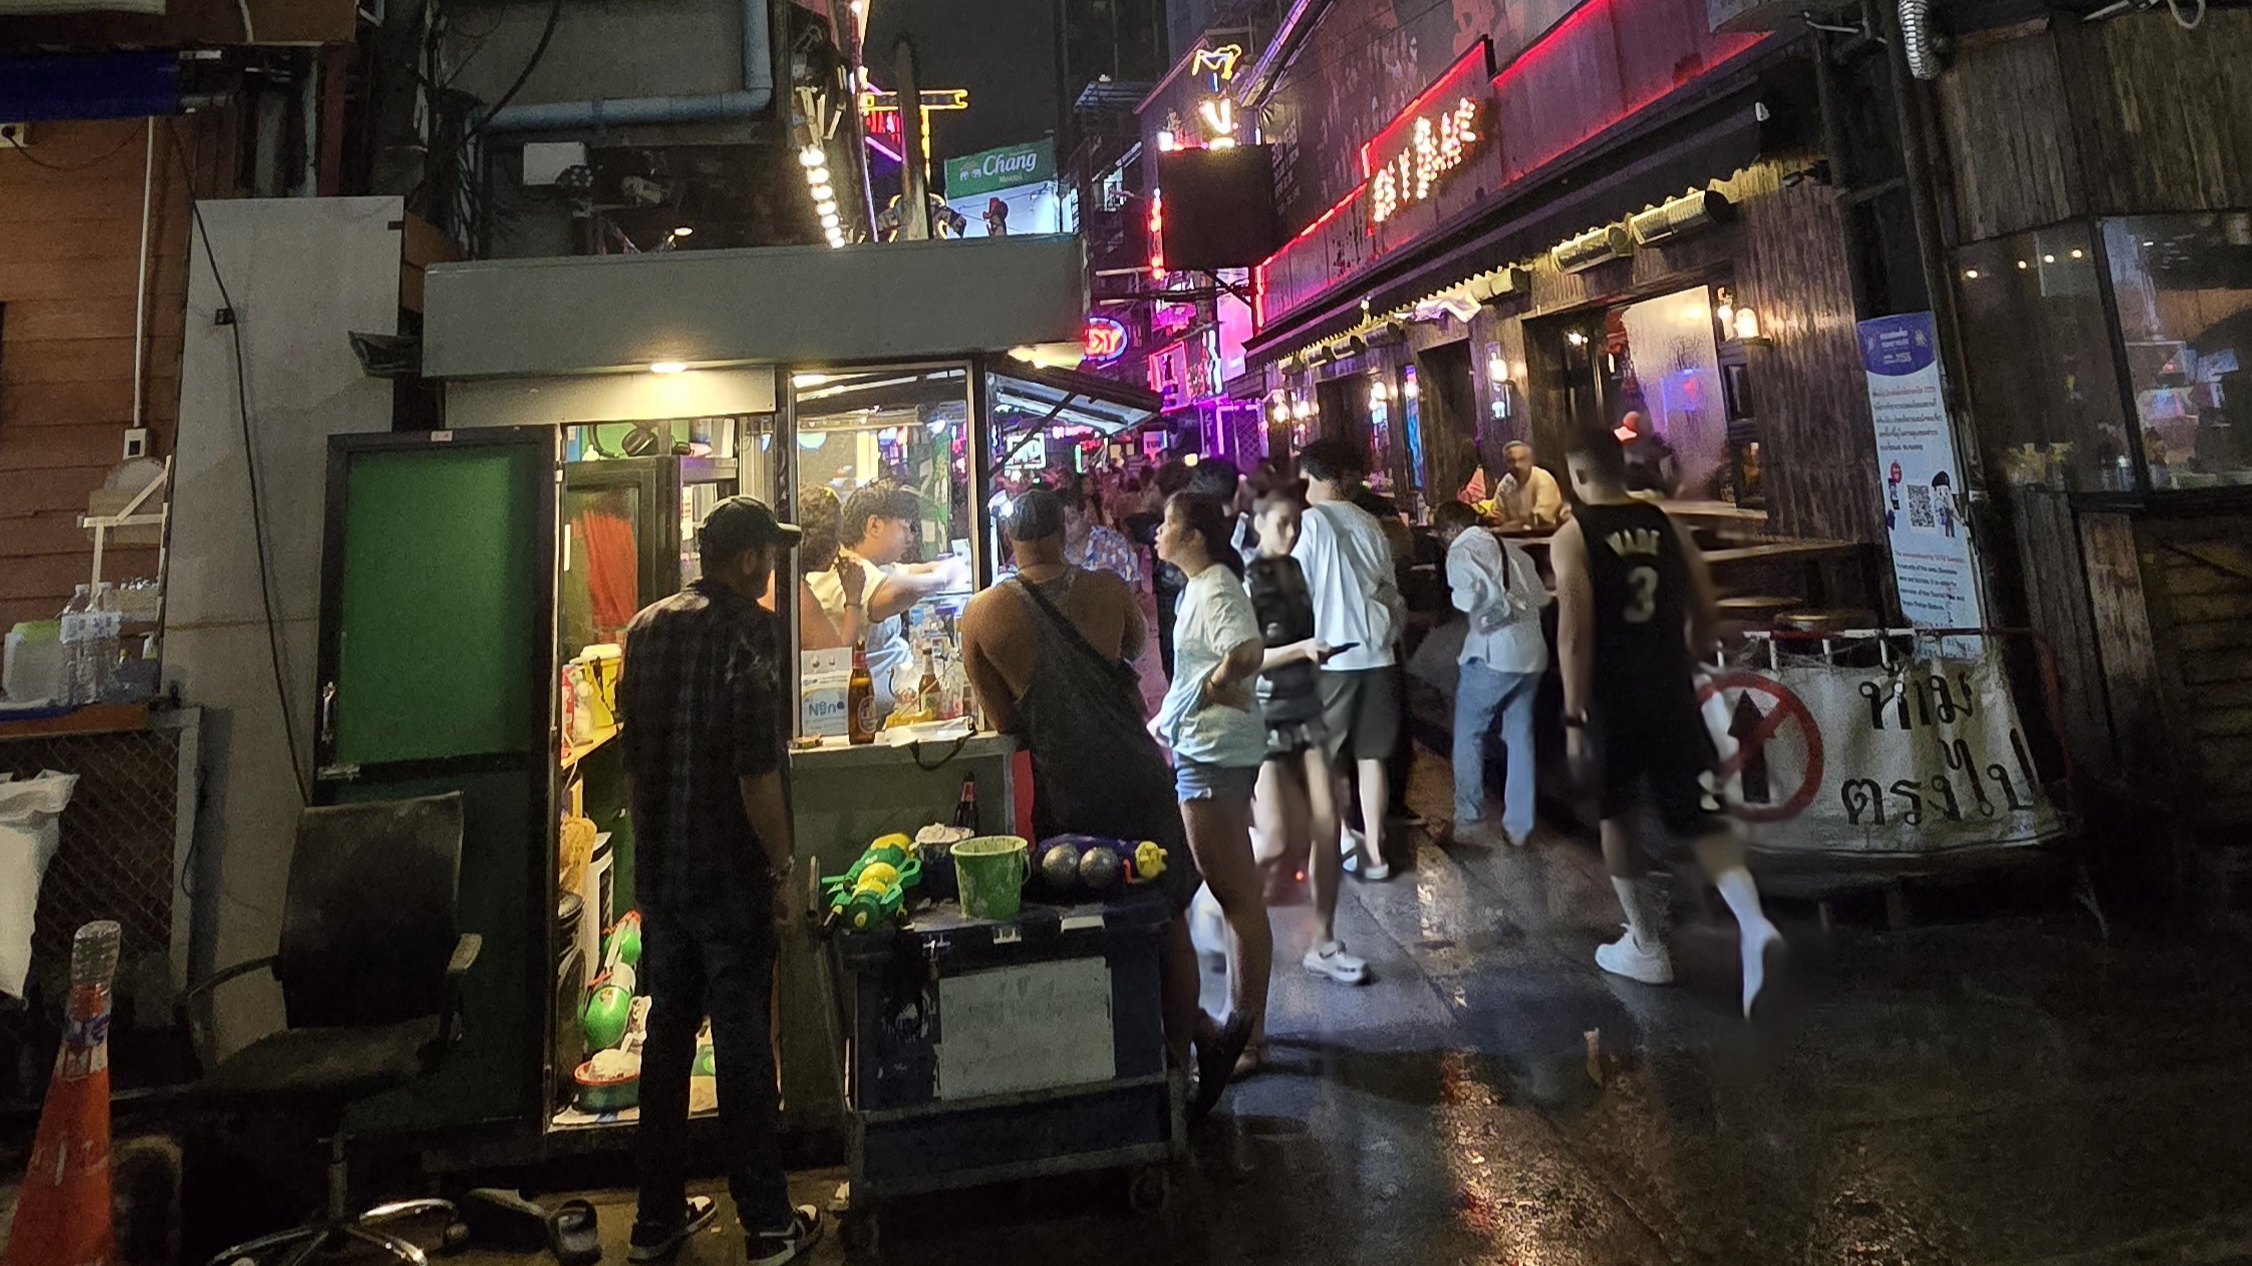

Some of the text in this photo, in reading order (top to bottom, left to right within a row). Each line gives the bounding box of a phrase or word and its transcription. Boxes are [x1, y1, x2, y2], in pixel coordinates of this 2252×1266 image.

[982, 152, 1038, 176] Chang
[1624, 565, 1659, 622] 3
[1858, 659, 1974, 730] ห้าม
[1840, 727, 2038, 827] ตรงไป
